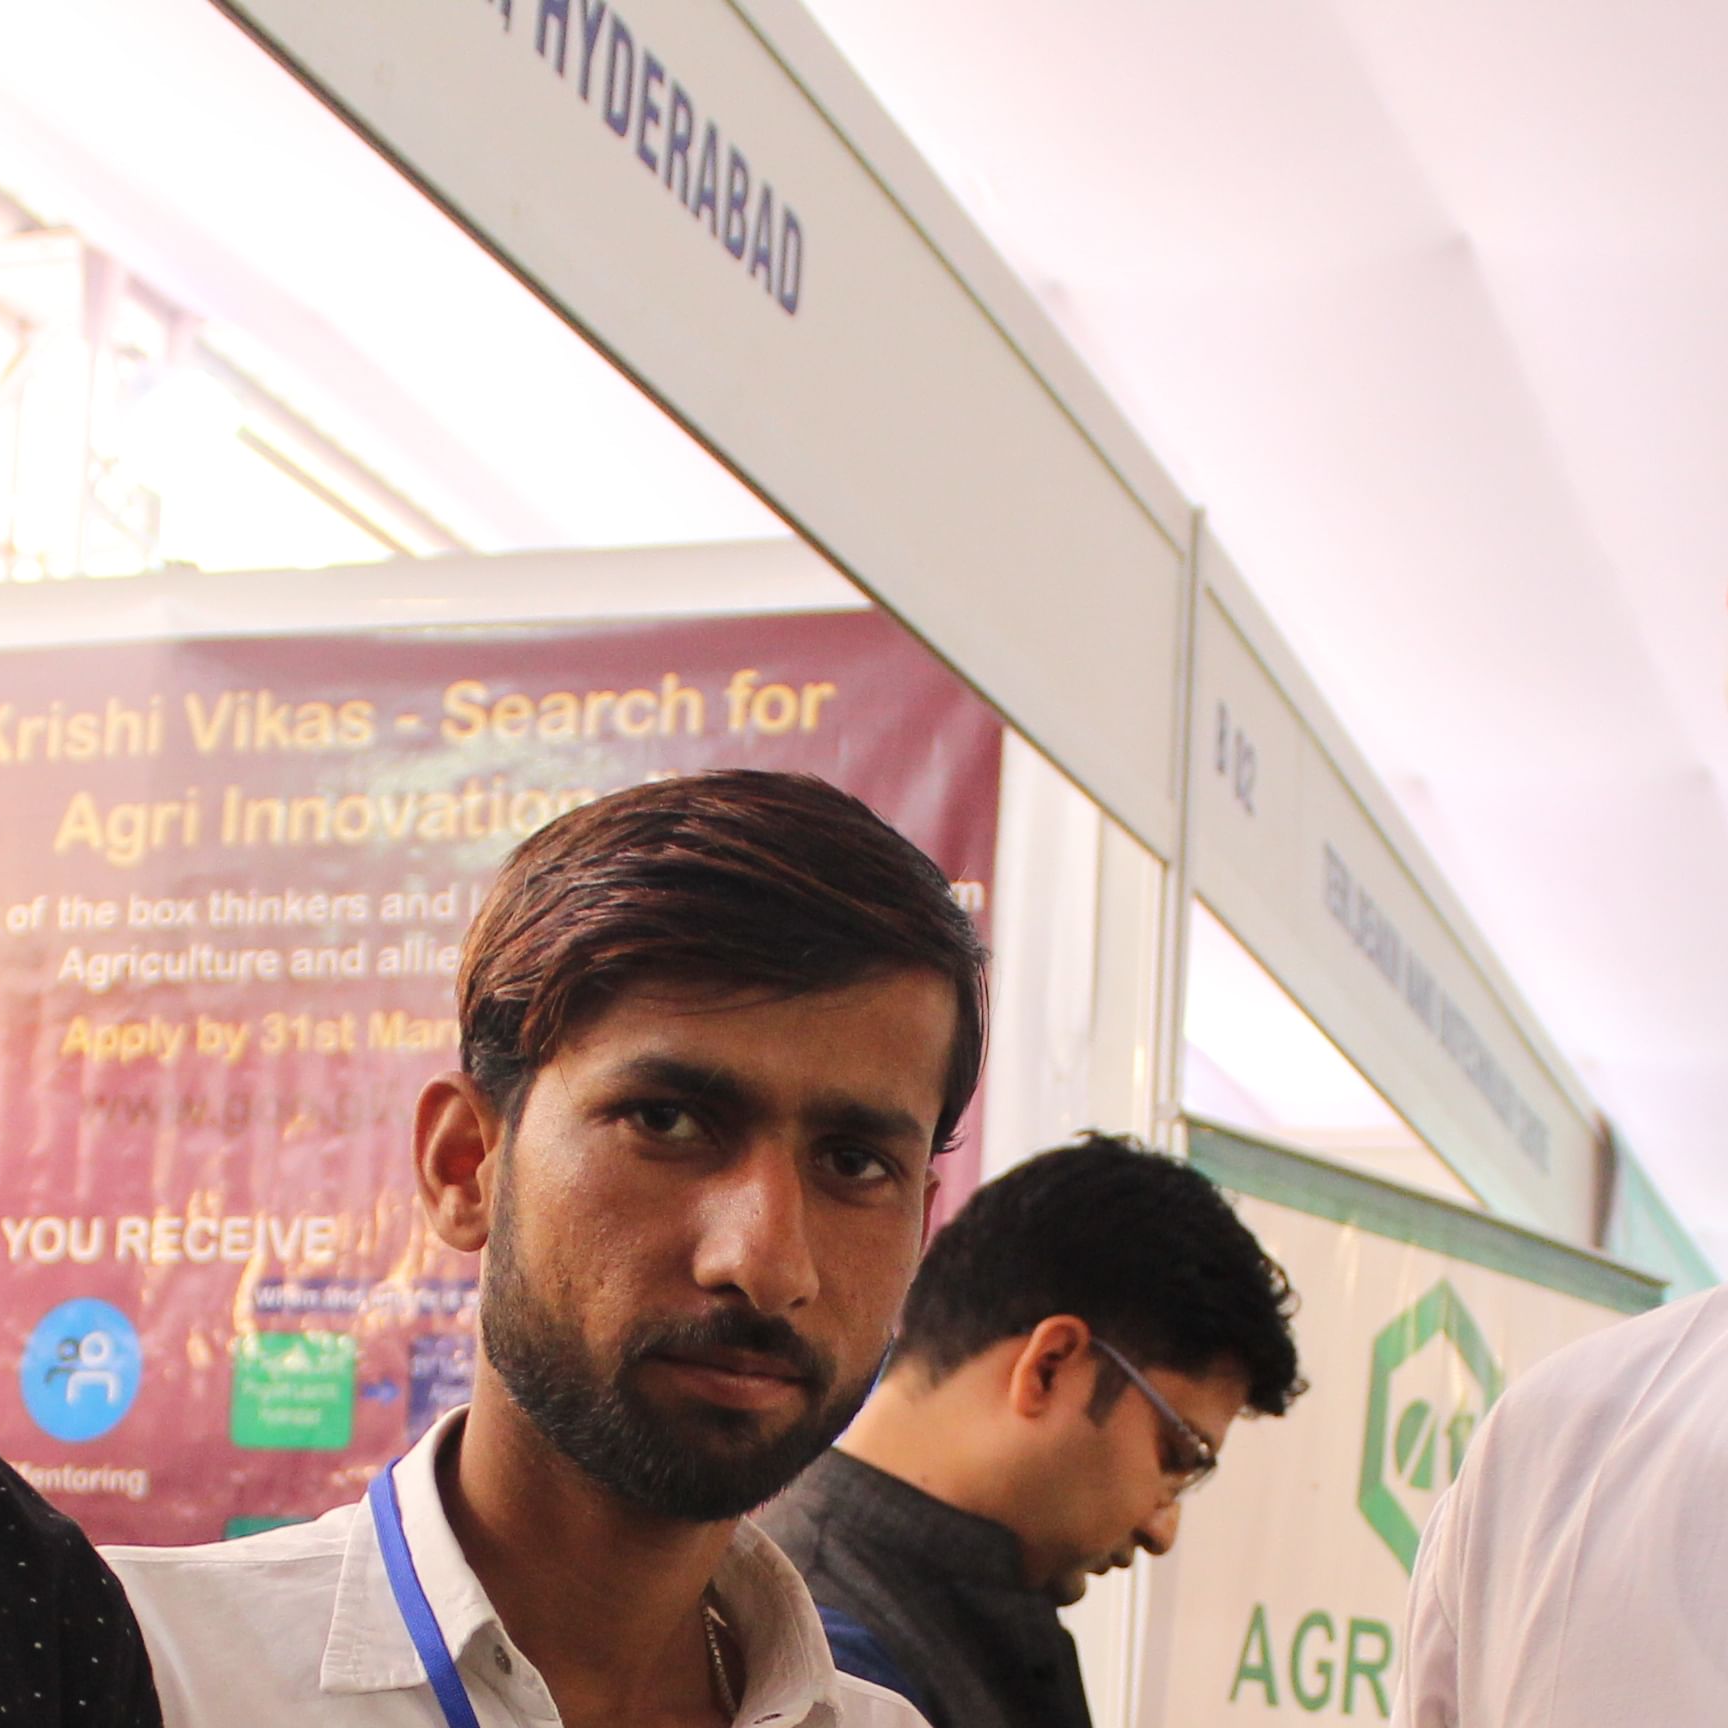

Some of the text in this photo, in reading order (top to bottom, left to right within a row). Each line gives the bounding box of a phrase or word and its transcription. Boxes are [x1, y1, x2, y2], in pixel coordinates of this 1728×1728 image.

[535, 0, 803, 316] HYDERABAD
[184, 688, 376, 753] Vikas
[441, 671, 705, 744] Search
[724, 667, 837, 737] for
[54, 786, 201, 867] Agri
[6, 895, 49, 933] of
[57, 894, 118, 930] the
[128, 889, 198, 928] box
[208, 888, 369, 928] thinkers
[379, 881, 458, 922] and
[57, 931, 461, 993] Agriculture and allie
[61, 1008, 462, 1064] Apply by 31st Mar
[1, 1215, 105, 1263] YOU
[116, 1214, 340, 1263] RECEIVE
[1227, 1600, 1394, 1719] AGR
